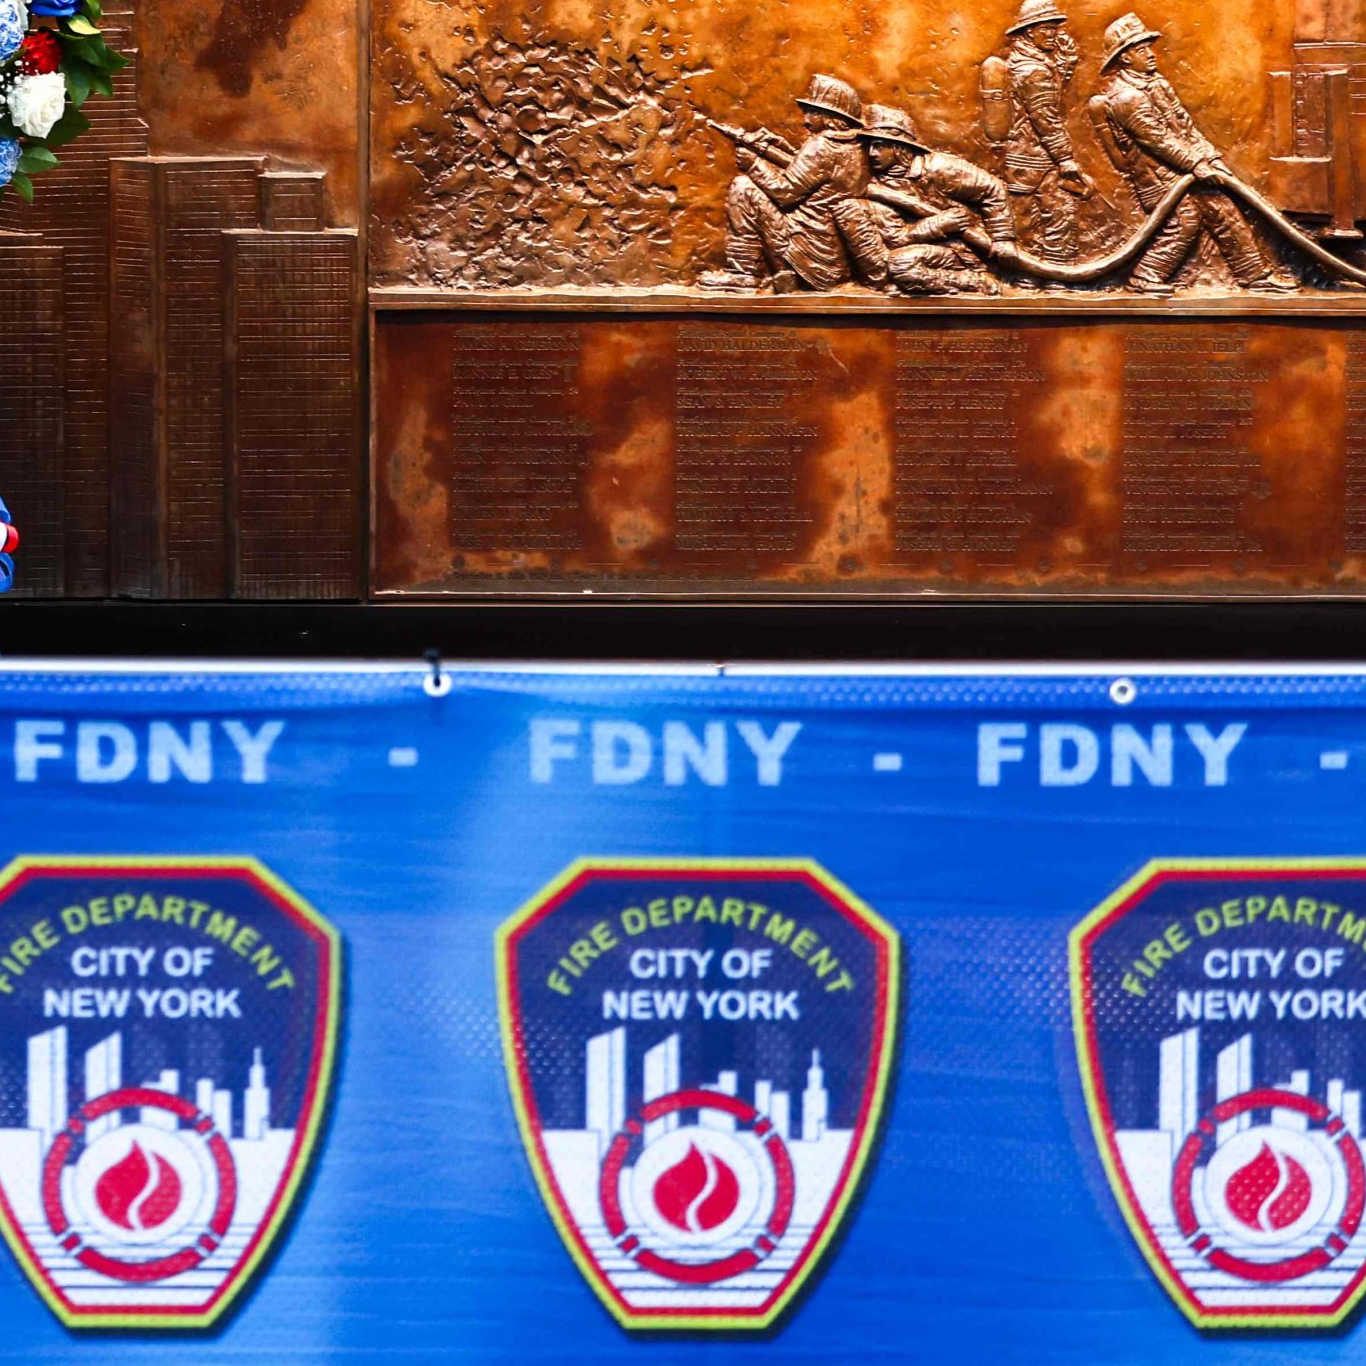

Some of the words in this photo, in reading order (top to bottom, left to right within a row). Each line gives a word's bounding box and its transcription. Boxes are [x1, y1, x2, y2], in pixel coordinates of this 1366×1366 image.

[14, 722, 283, 784] FDNY
[529, 720, 800, 785] FDNY
[977, 724, 1247, 786] FDNY
[61, 893, 296, 992] DEPARTMENT
[547, 921, 619, 996] FIRE
[621, 895, 855, 994] DEPARTMENT
[71, 946, 155, 977] CITY
[163, 946, 214, 977] OF
[629, 948, 714, 978] CITY
[721, 948, 773, 978] OF
[1121, 923, 1193, 998] FIRE
[1203, 948, 1285, 979] CITY
[1294, 947, 1345, 978] OF
[44, 988, 131, 1018] NEW
[137, 988, 241, 1018] YORK
[603, 991, 688, 1020] NEW
[696, 990, 799, 1020] YORK
[1176, 991, 1263, 1020] NEW
